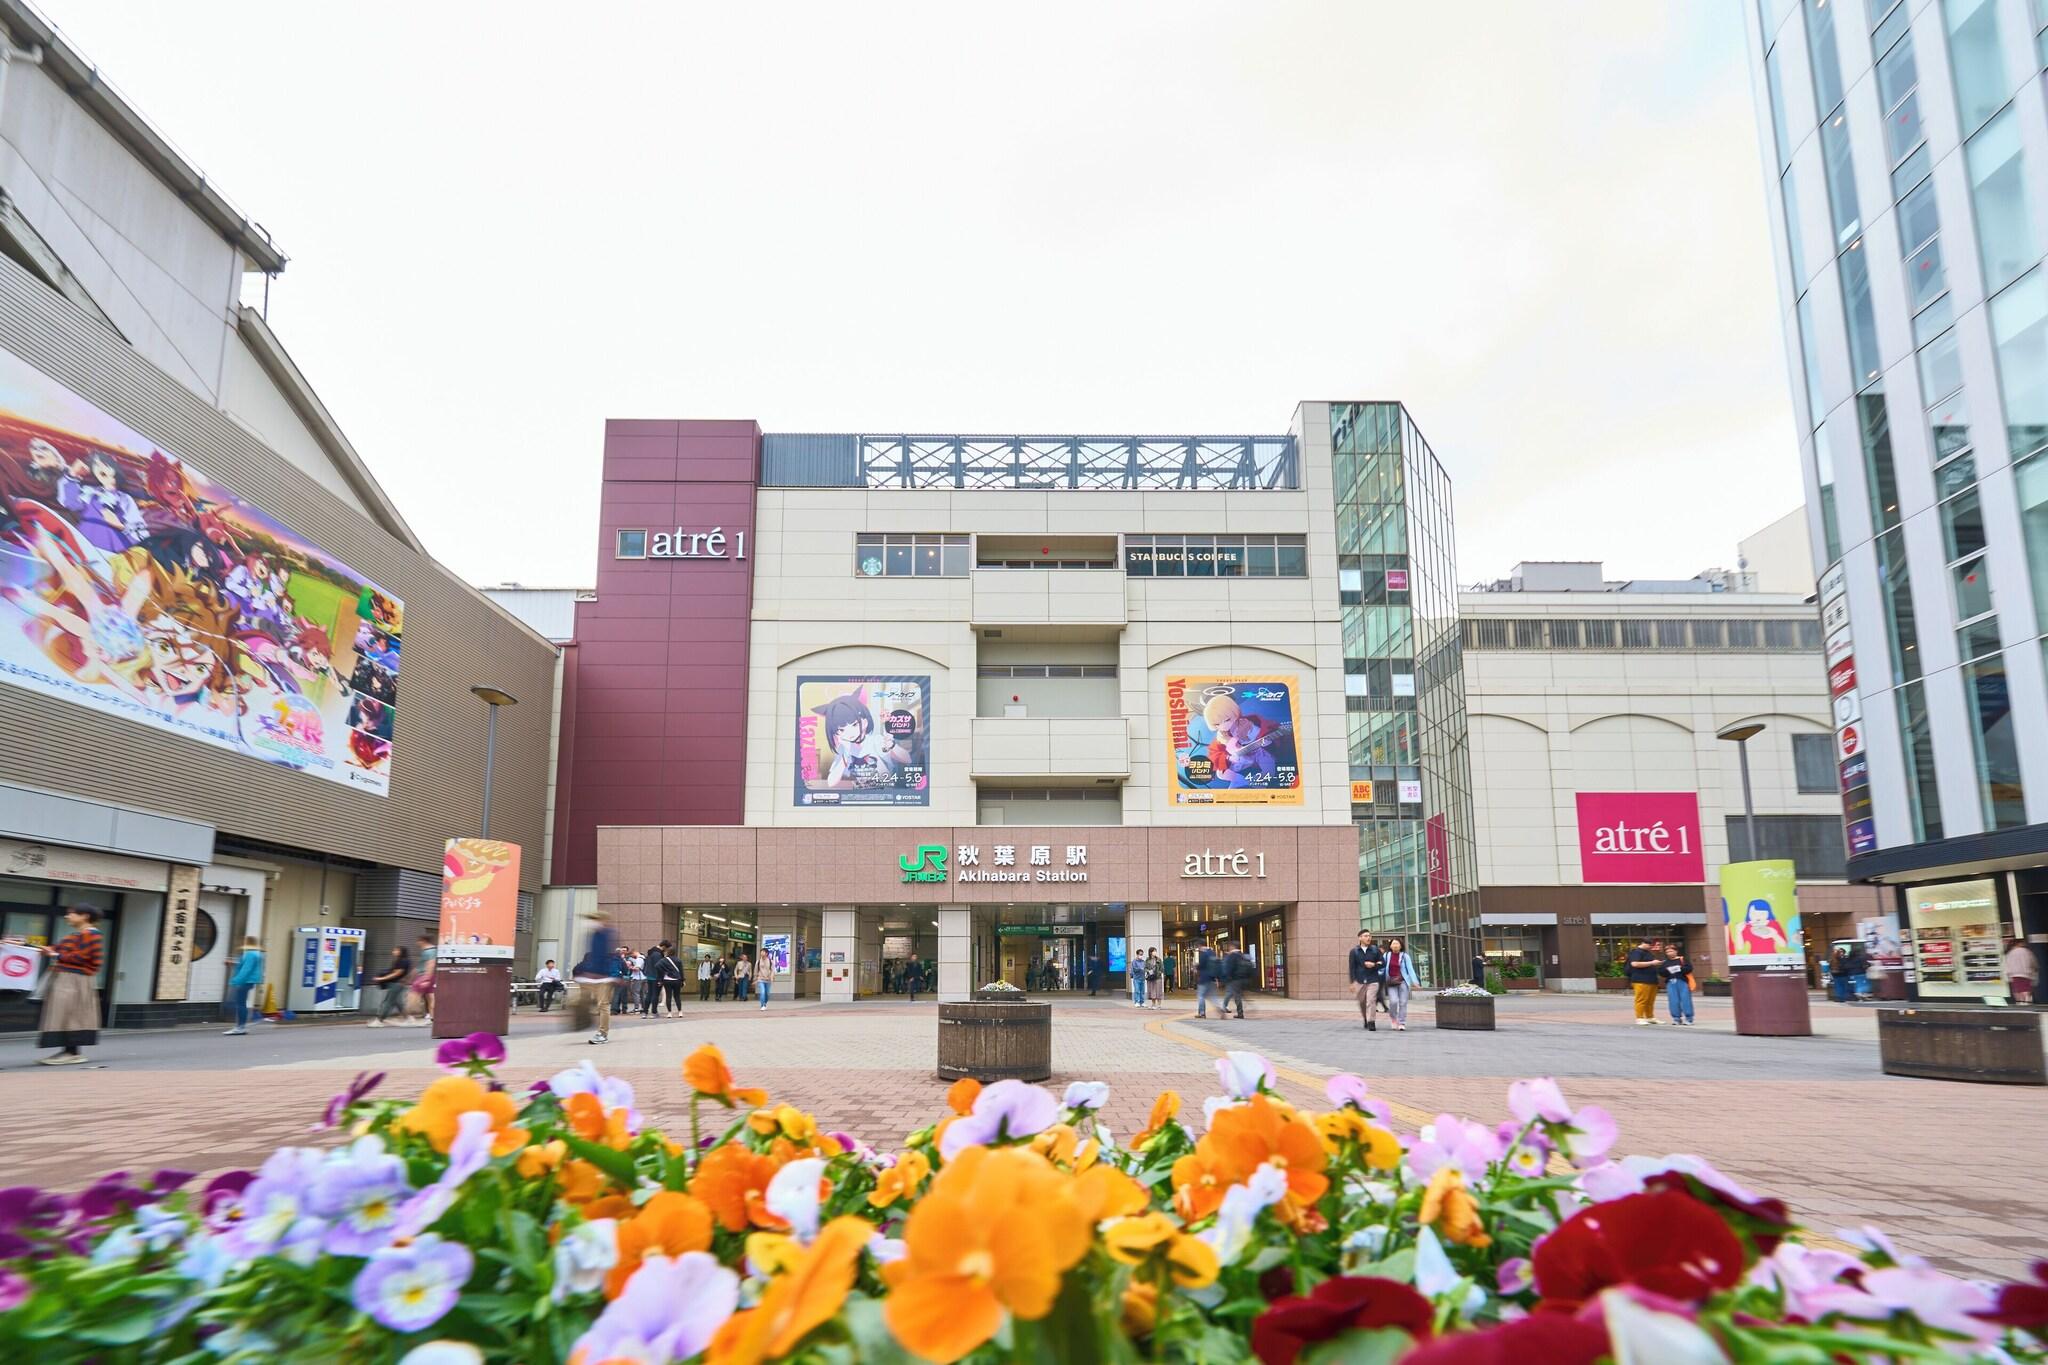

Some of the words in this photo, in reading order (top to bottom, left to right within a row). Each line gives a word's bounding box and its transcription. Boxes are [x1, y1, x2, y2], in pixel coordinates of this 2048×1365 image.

[651, 526, 727, 557] atré
[735, 531, 747, 559] 1
[1595, 821, 1671, 852] atré
[1676, 826, 1692, 854] 1
[900, 845, 948, 871] JR
[958, 845, 1087, 866] 秋葉原駅
[1184, 848, 1250, 875] atré
[1256, 852, 1267, 878] 1
[958, 870, 1031, 882] Akihabara
[1036, 870, 1088, 882] Station
